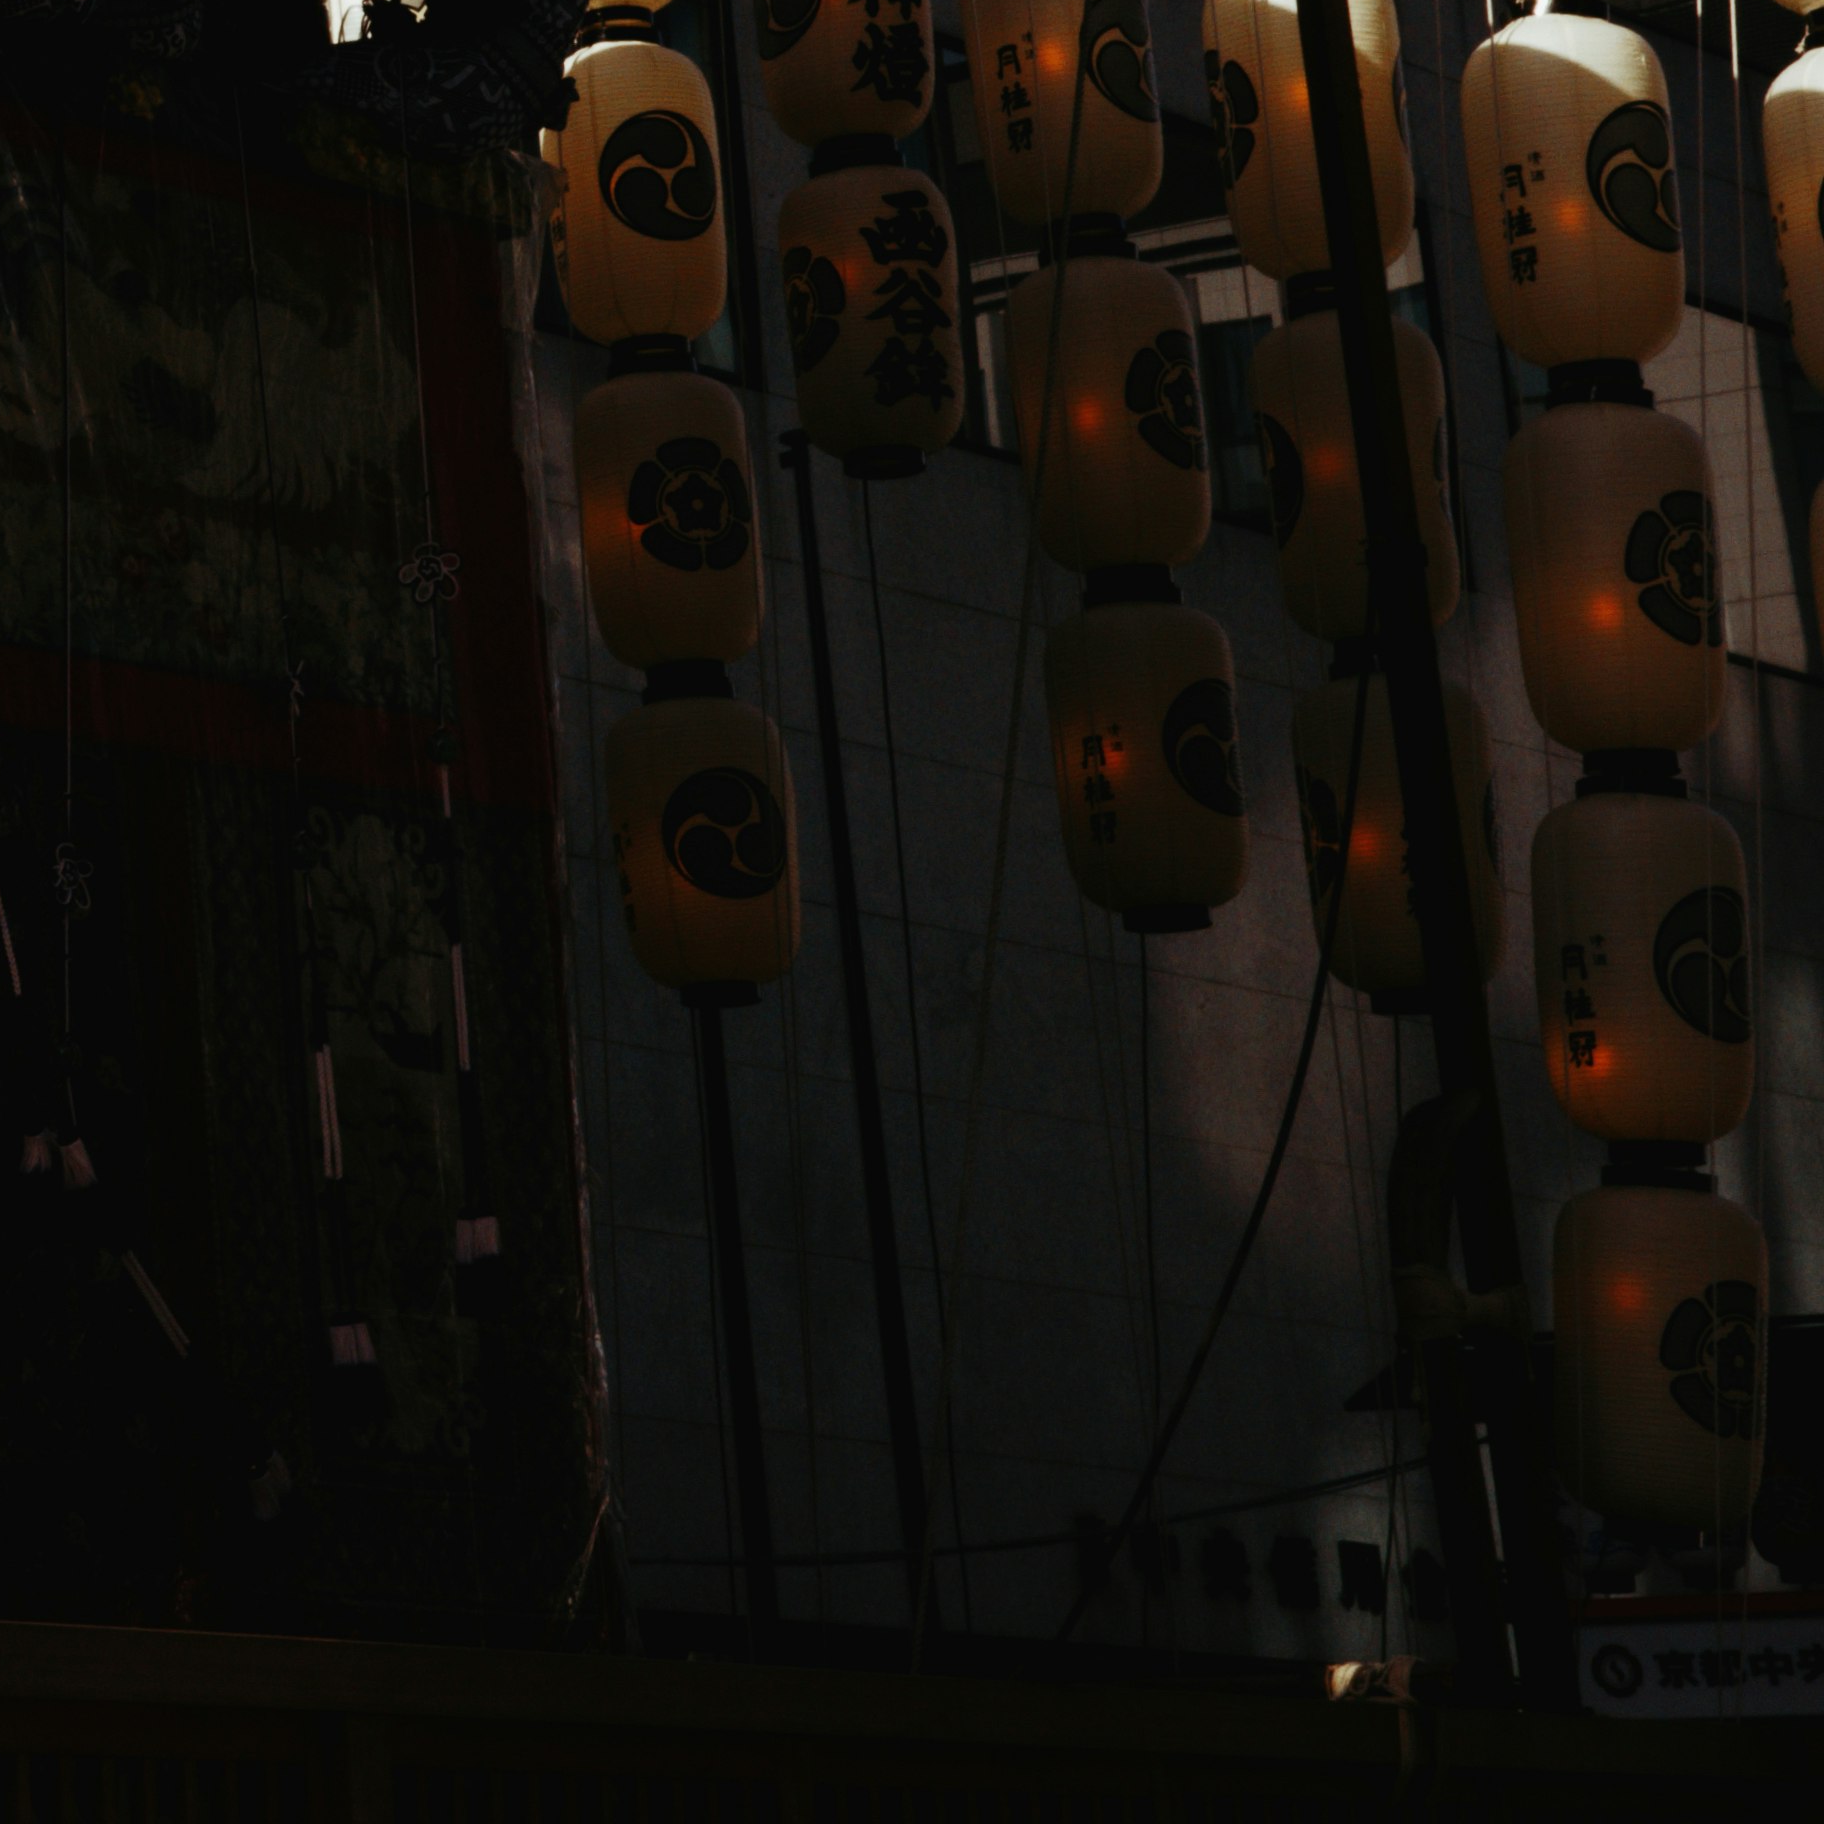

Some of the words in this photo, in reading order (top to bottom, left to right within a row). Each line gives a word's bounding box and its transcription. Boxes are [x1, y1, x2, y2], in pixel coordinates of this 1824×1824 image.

[996, 43, 1032, 154] 月桂冠
[1500, 164, 1538, 286] 月桂冠
[1561, 943, 1597, 1069] 月桂冠
